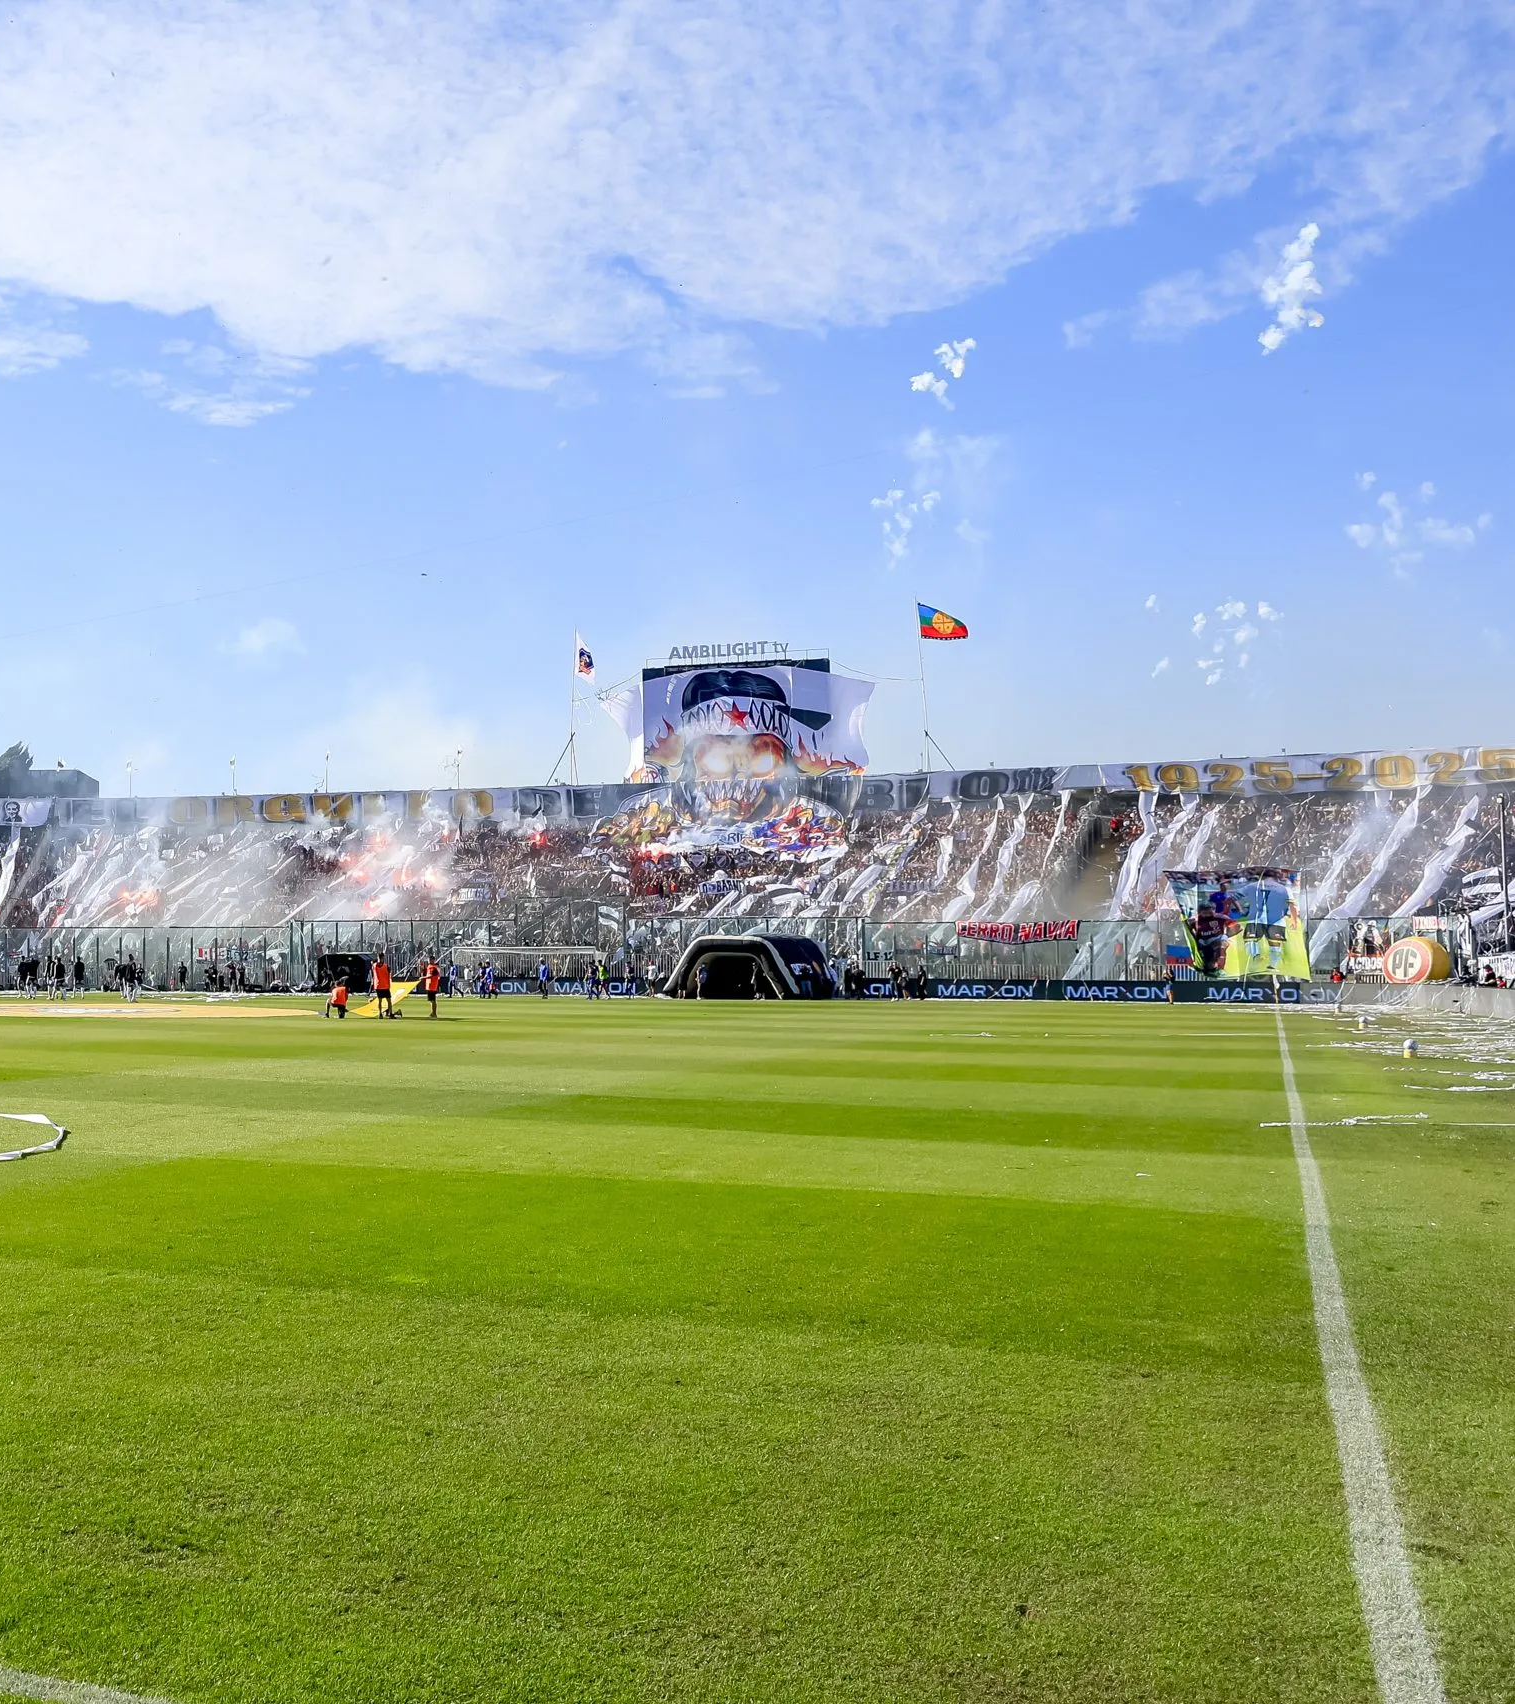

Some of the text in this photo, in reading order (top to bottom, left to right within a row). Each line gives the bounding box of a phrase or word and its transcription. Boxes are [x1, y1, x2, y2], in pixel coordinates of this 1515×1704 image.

[669, 641, 768, 660] AMBILIGHT
[1125, 748, 1515, 793] 1925-2025
[955, 919, 1078, 943] CERRO NAVIA
[1392, 948, 1418, 978] PF
